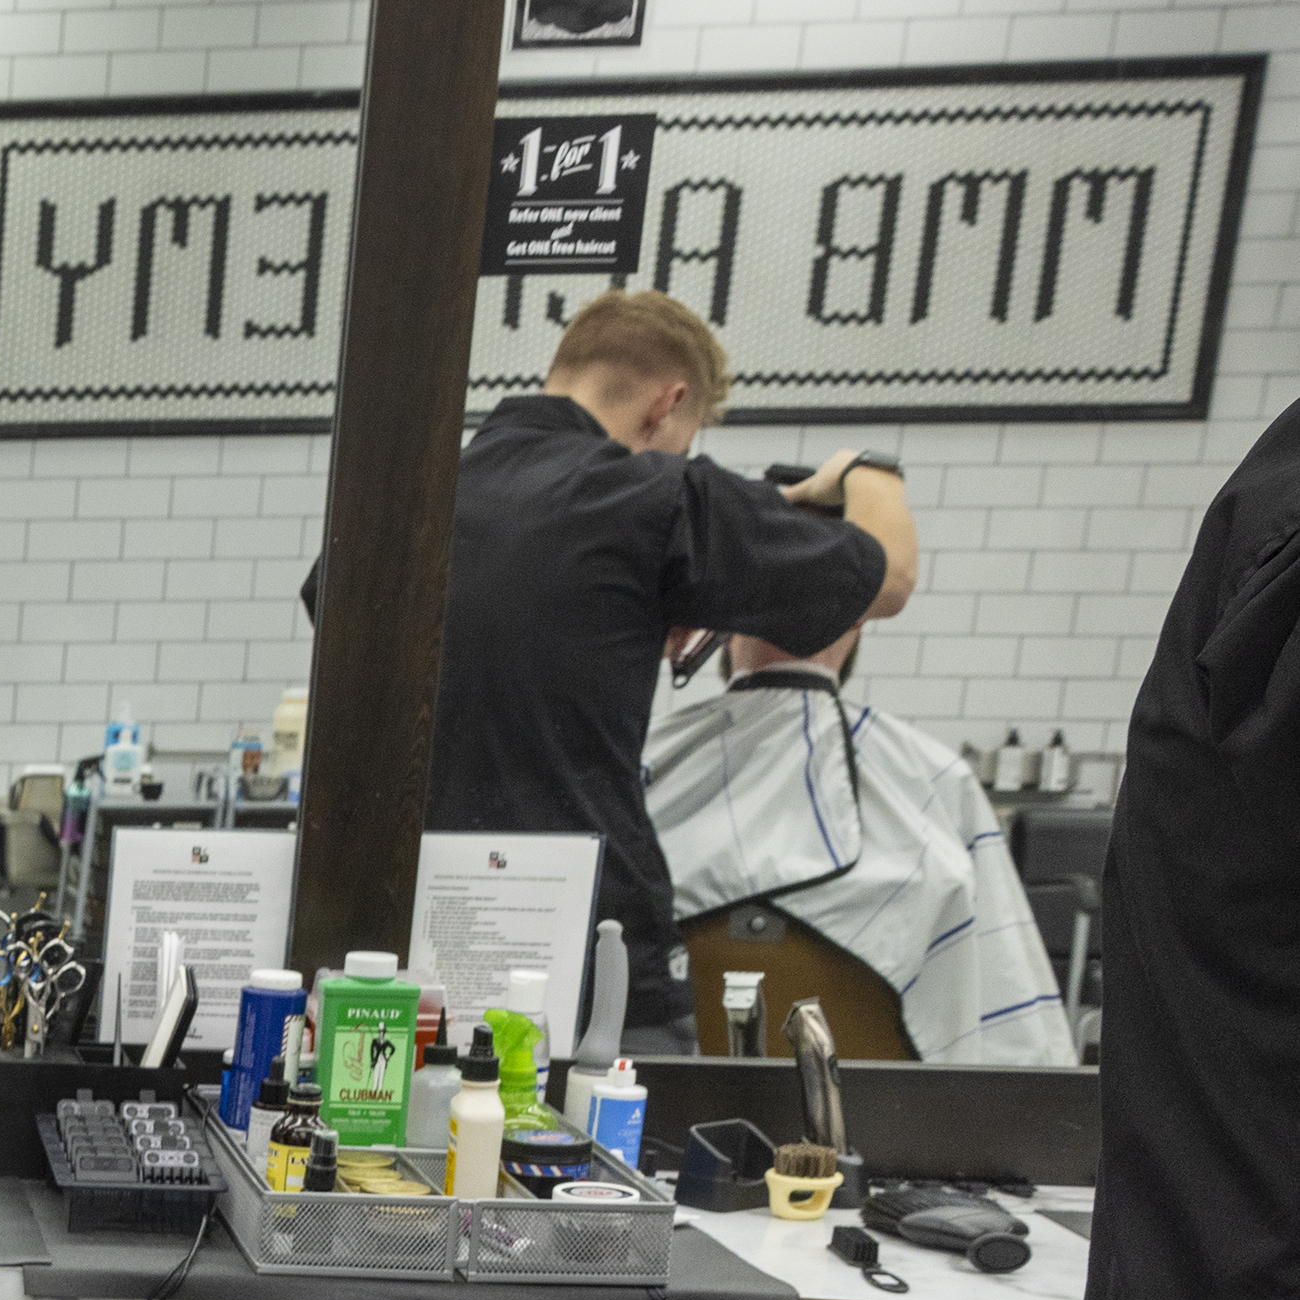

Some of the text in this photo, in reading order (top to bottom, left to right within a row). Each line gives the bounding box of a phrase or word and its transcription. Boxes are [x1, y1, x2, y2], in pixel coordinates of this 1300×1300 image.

[517, 124, 622, 196] 1 for 1
[509, 206, 622, 223] Refer ONE new client
[507, 239, 616, 255] Get ONE free haircut
[347, 1008, 400, 1020] PINAUD
[339, 1087, 394, 1102] CLUBMAN
